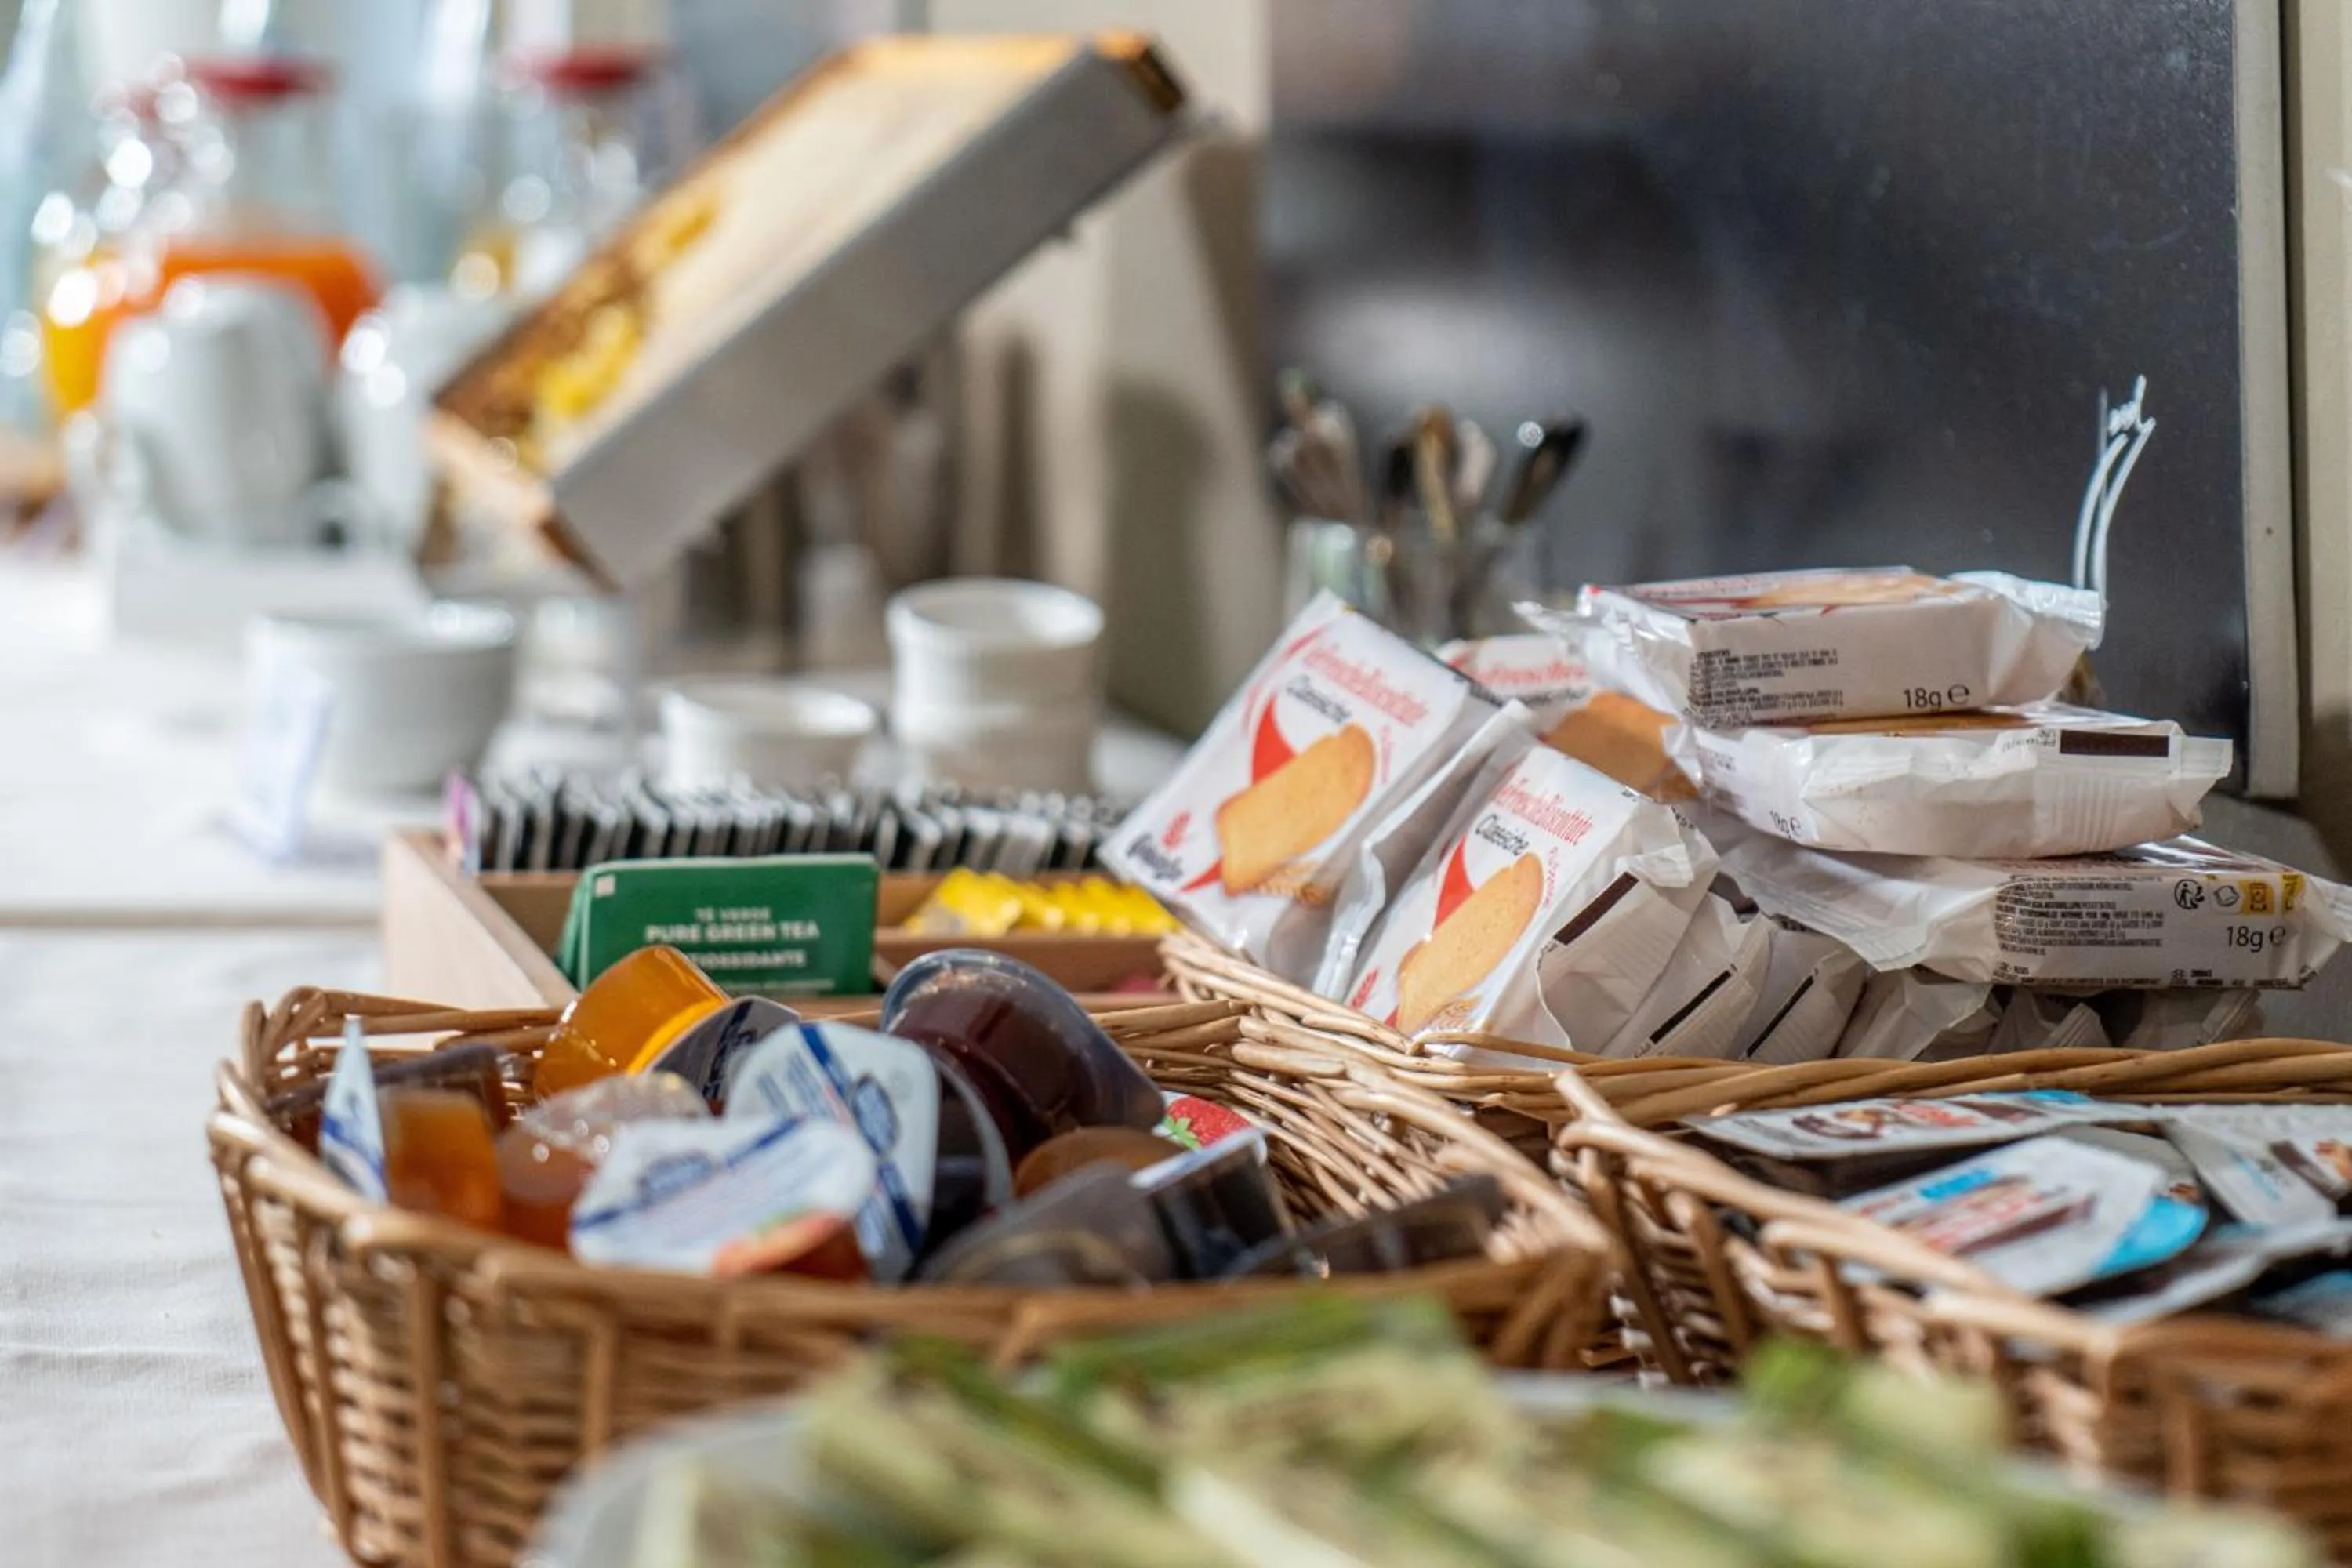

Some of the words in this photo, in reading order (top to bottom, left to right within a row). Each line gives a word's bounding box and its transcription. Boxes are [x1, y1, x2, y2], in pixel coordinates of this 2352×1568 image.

[1903, 687, 1942, 713] 18g
[720, 907, 770, 920] VERDE
[646, 924, 700, 942] PURE
[706, 923, 775, 942] GREEN
[781, 920, 819, 939] TEA
[2226, 925, 2263, 953] 18g
[688, 950, 806, 968] TIOSSIDANTE
